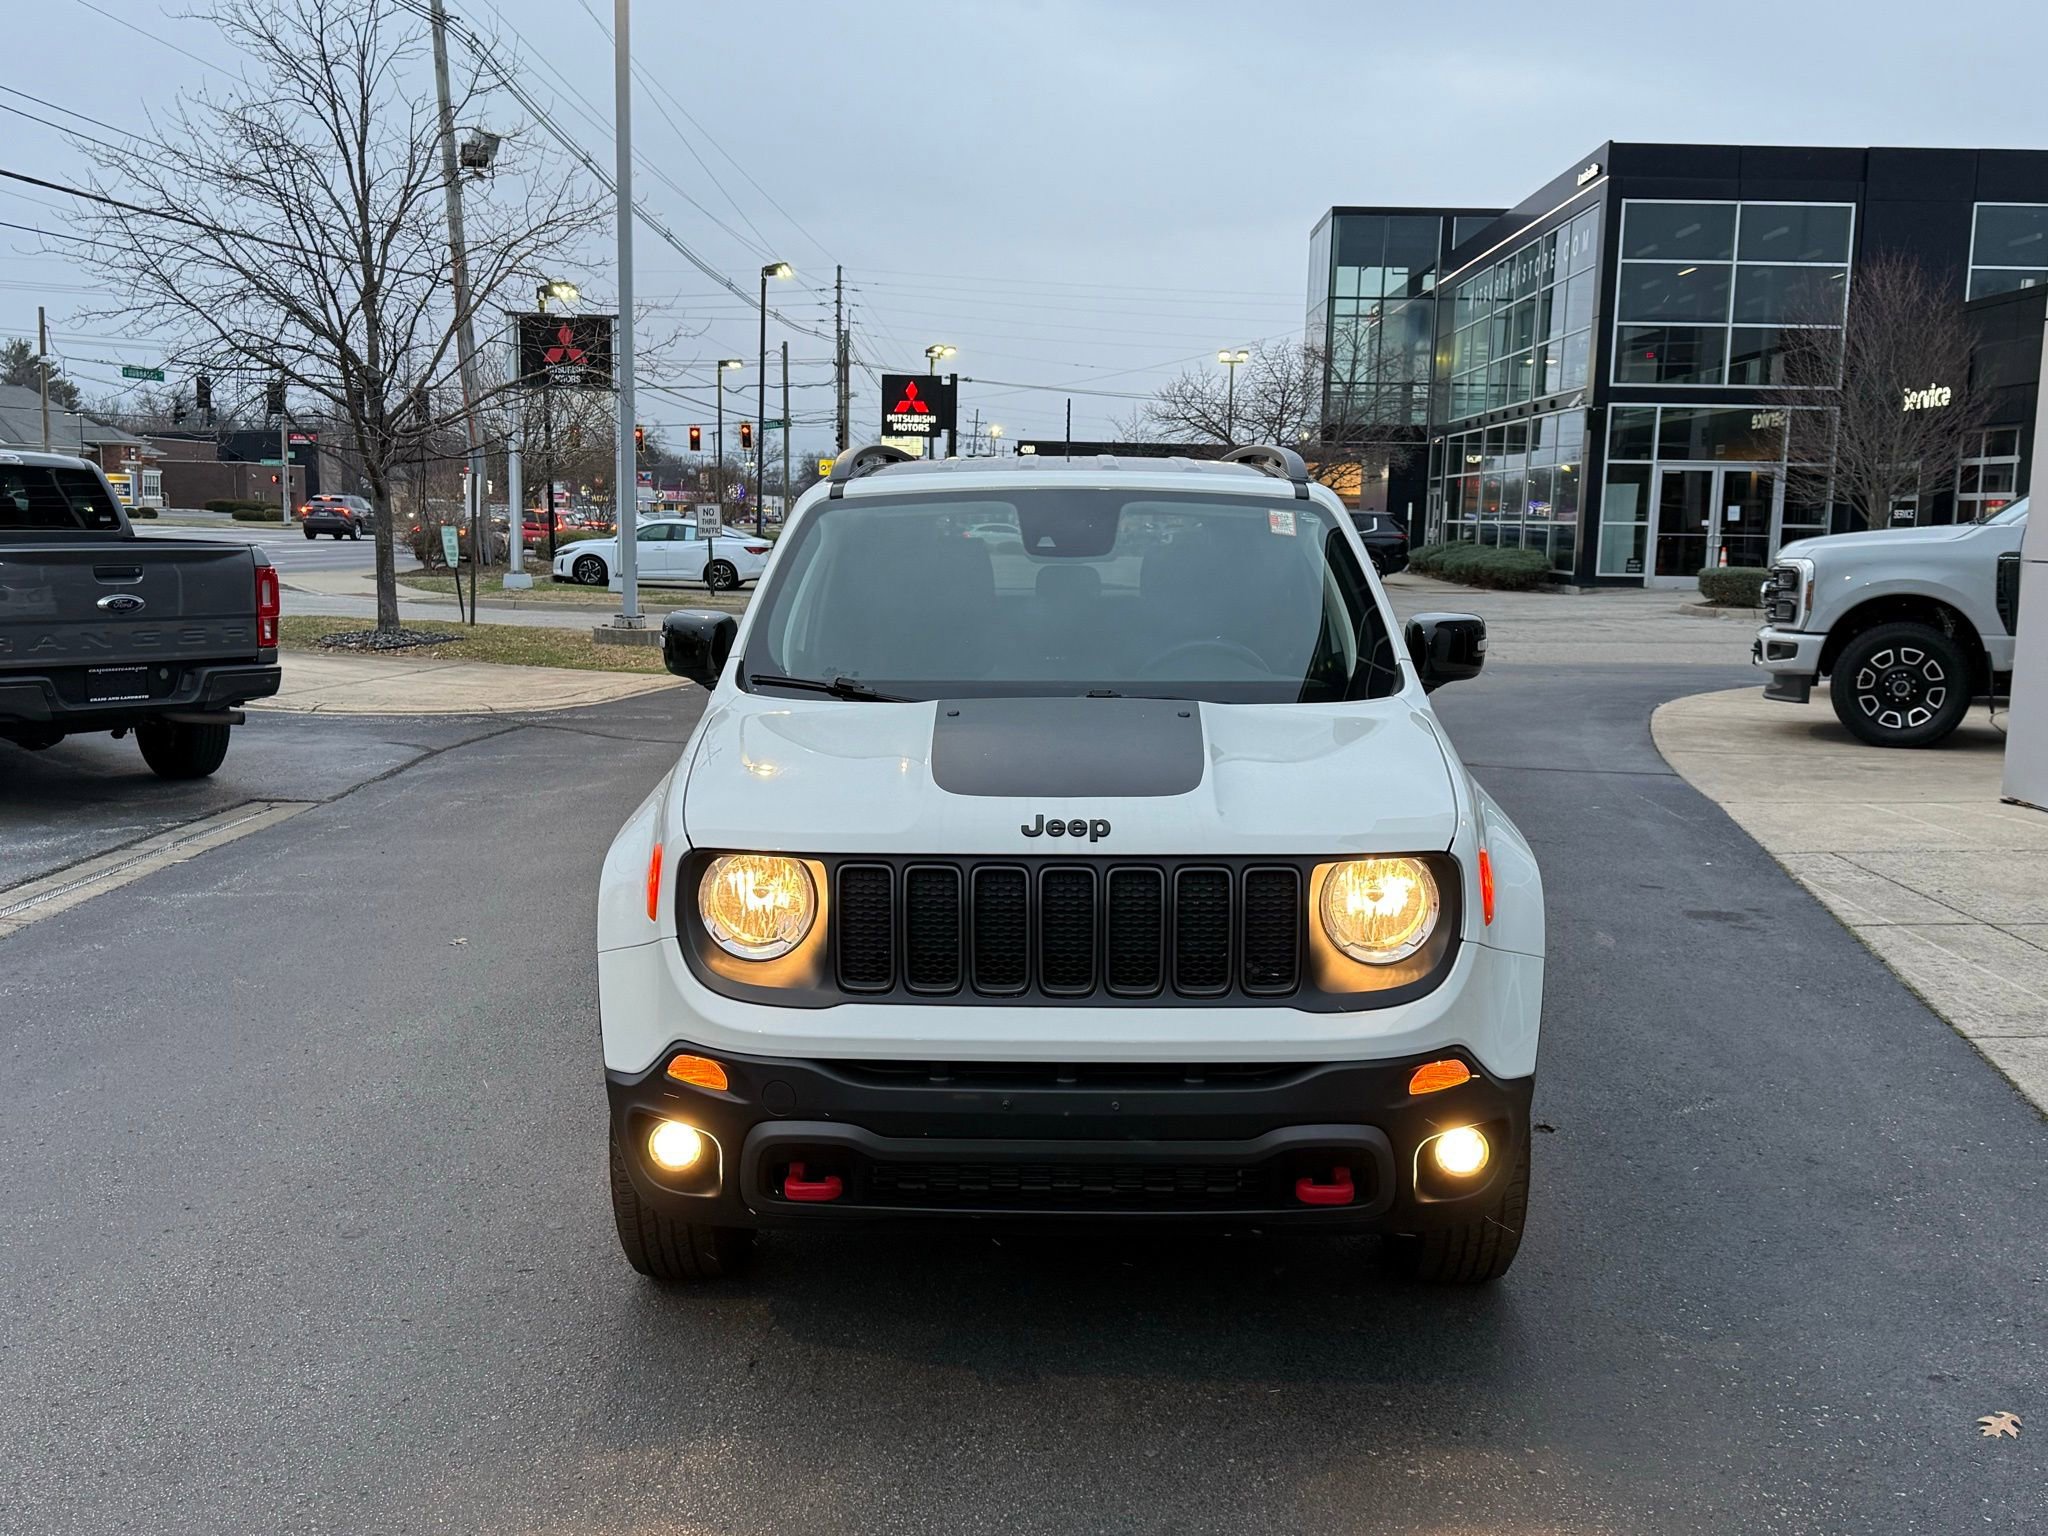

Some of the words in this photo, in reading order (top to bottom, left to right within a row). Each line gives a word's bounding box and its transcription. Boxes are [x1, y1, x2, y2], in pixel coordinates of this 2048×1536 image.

[886, 414, 937, 423] MITSUBISHI
[893, 423, 930, 432] MOTORS
[703, 507, 715, 517] NO
[1893, 509, 1915, 519] SERVICE
[699, 527, 721, 535] TRAFFIC
[1020, 814, 1112, 843] Jeep
